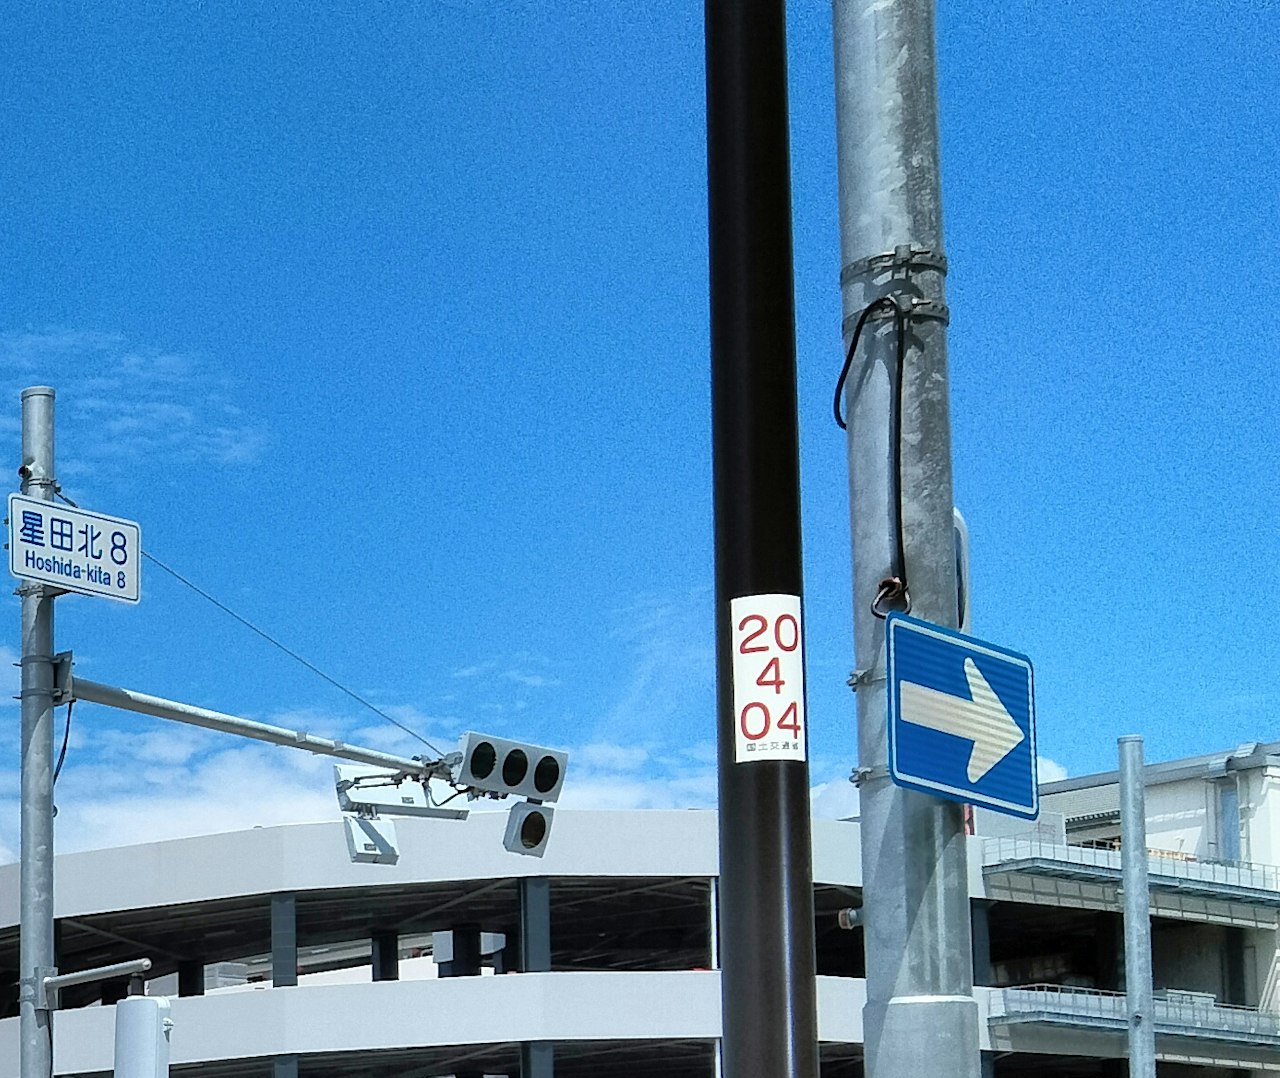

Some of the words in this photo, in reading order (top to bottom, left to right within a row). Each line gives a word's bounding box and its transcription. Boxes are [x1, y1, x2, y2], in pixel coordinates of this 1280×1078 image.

[25, 549, 111, 587] Hoshida-kita
[116, 570, 126, 590] 8
[738, 613, 799, 654] 20
[756, 657, 785, 695] 4
[740, 701, 801, 740] 04
